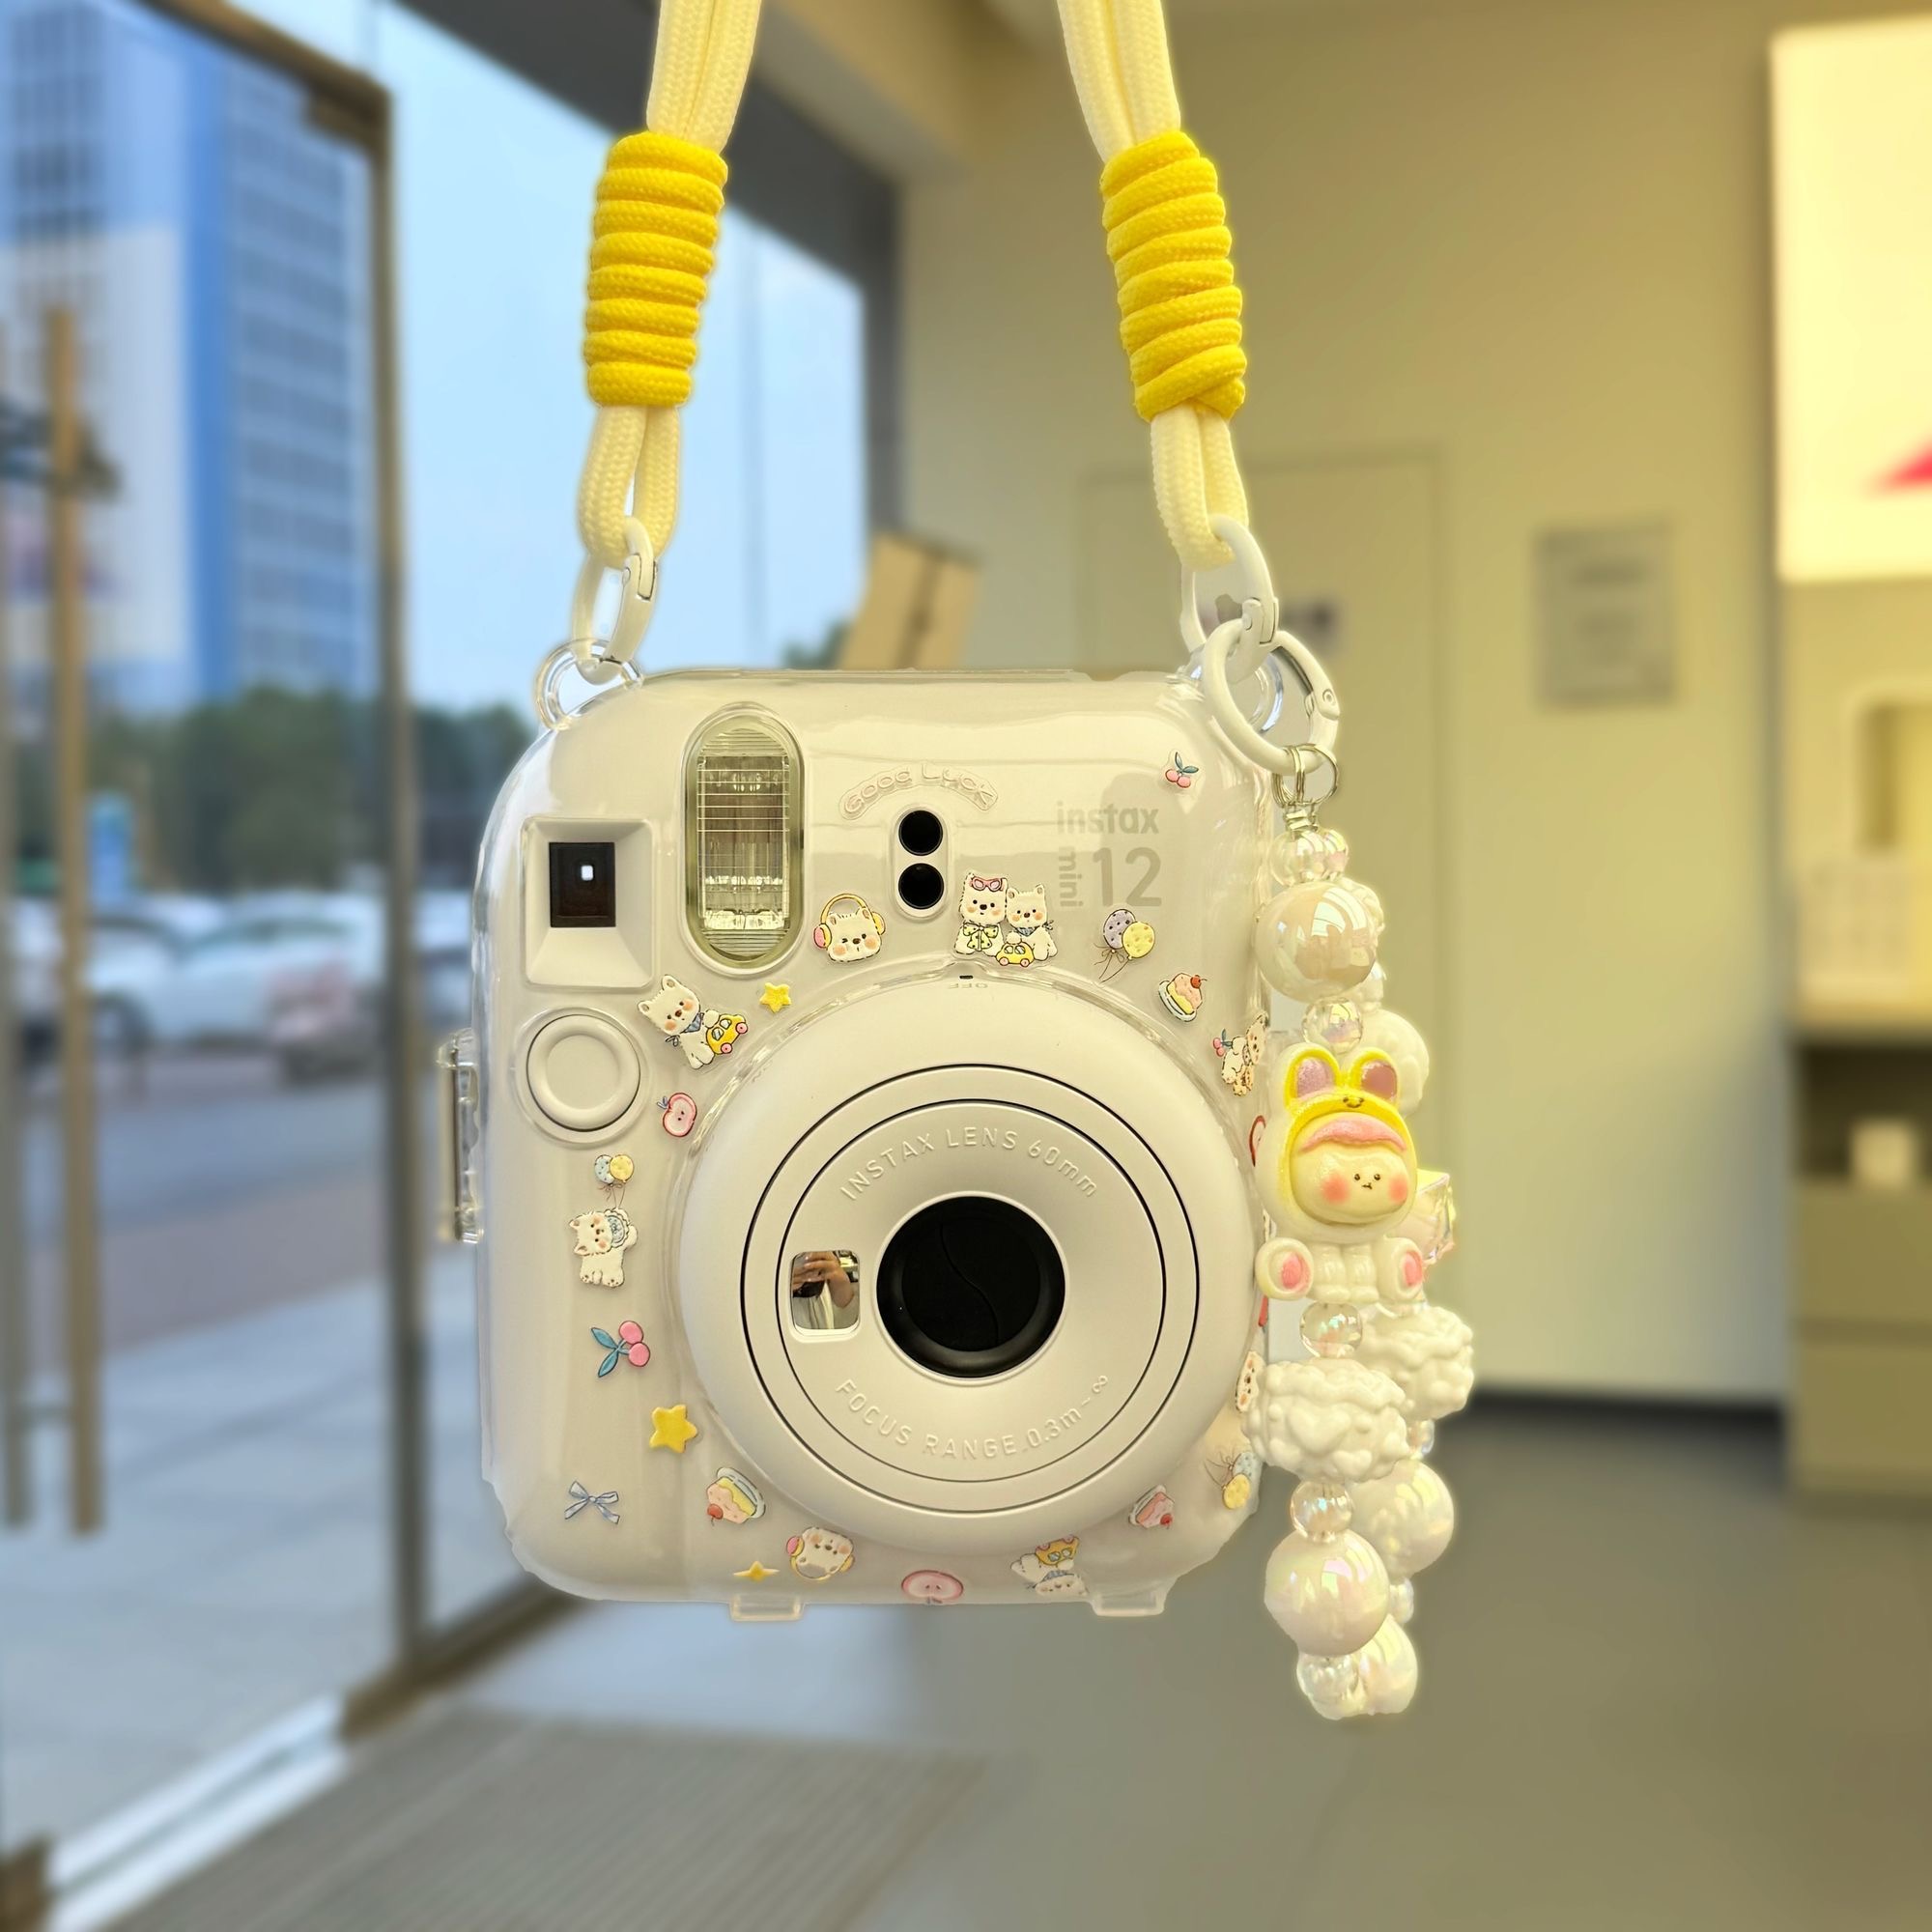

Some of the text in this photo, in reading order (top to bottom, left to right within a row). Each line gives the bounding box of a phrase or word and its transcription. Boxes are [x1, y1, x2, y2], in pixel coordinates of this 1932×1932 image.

[1057, 801, 1160, 834] instax
[1058, 846, 1084, 907] mini
[1093, 846, 1162, 907] 12
[839, 1126, 1098, 1202] INSTAX LENS 60mm
[835, 1378, 913, 1446] FOCUS
[923, 1434, 1018, 1460] RANGE
